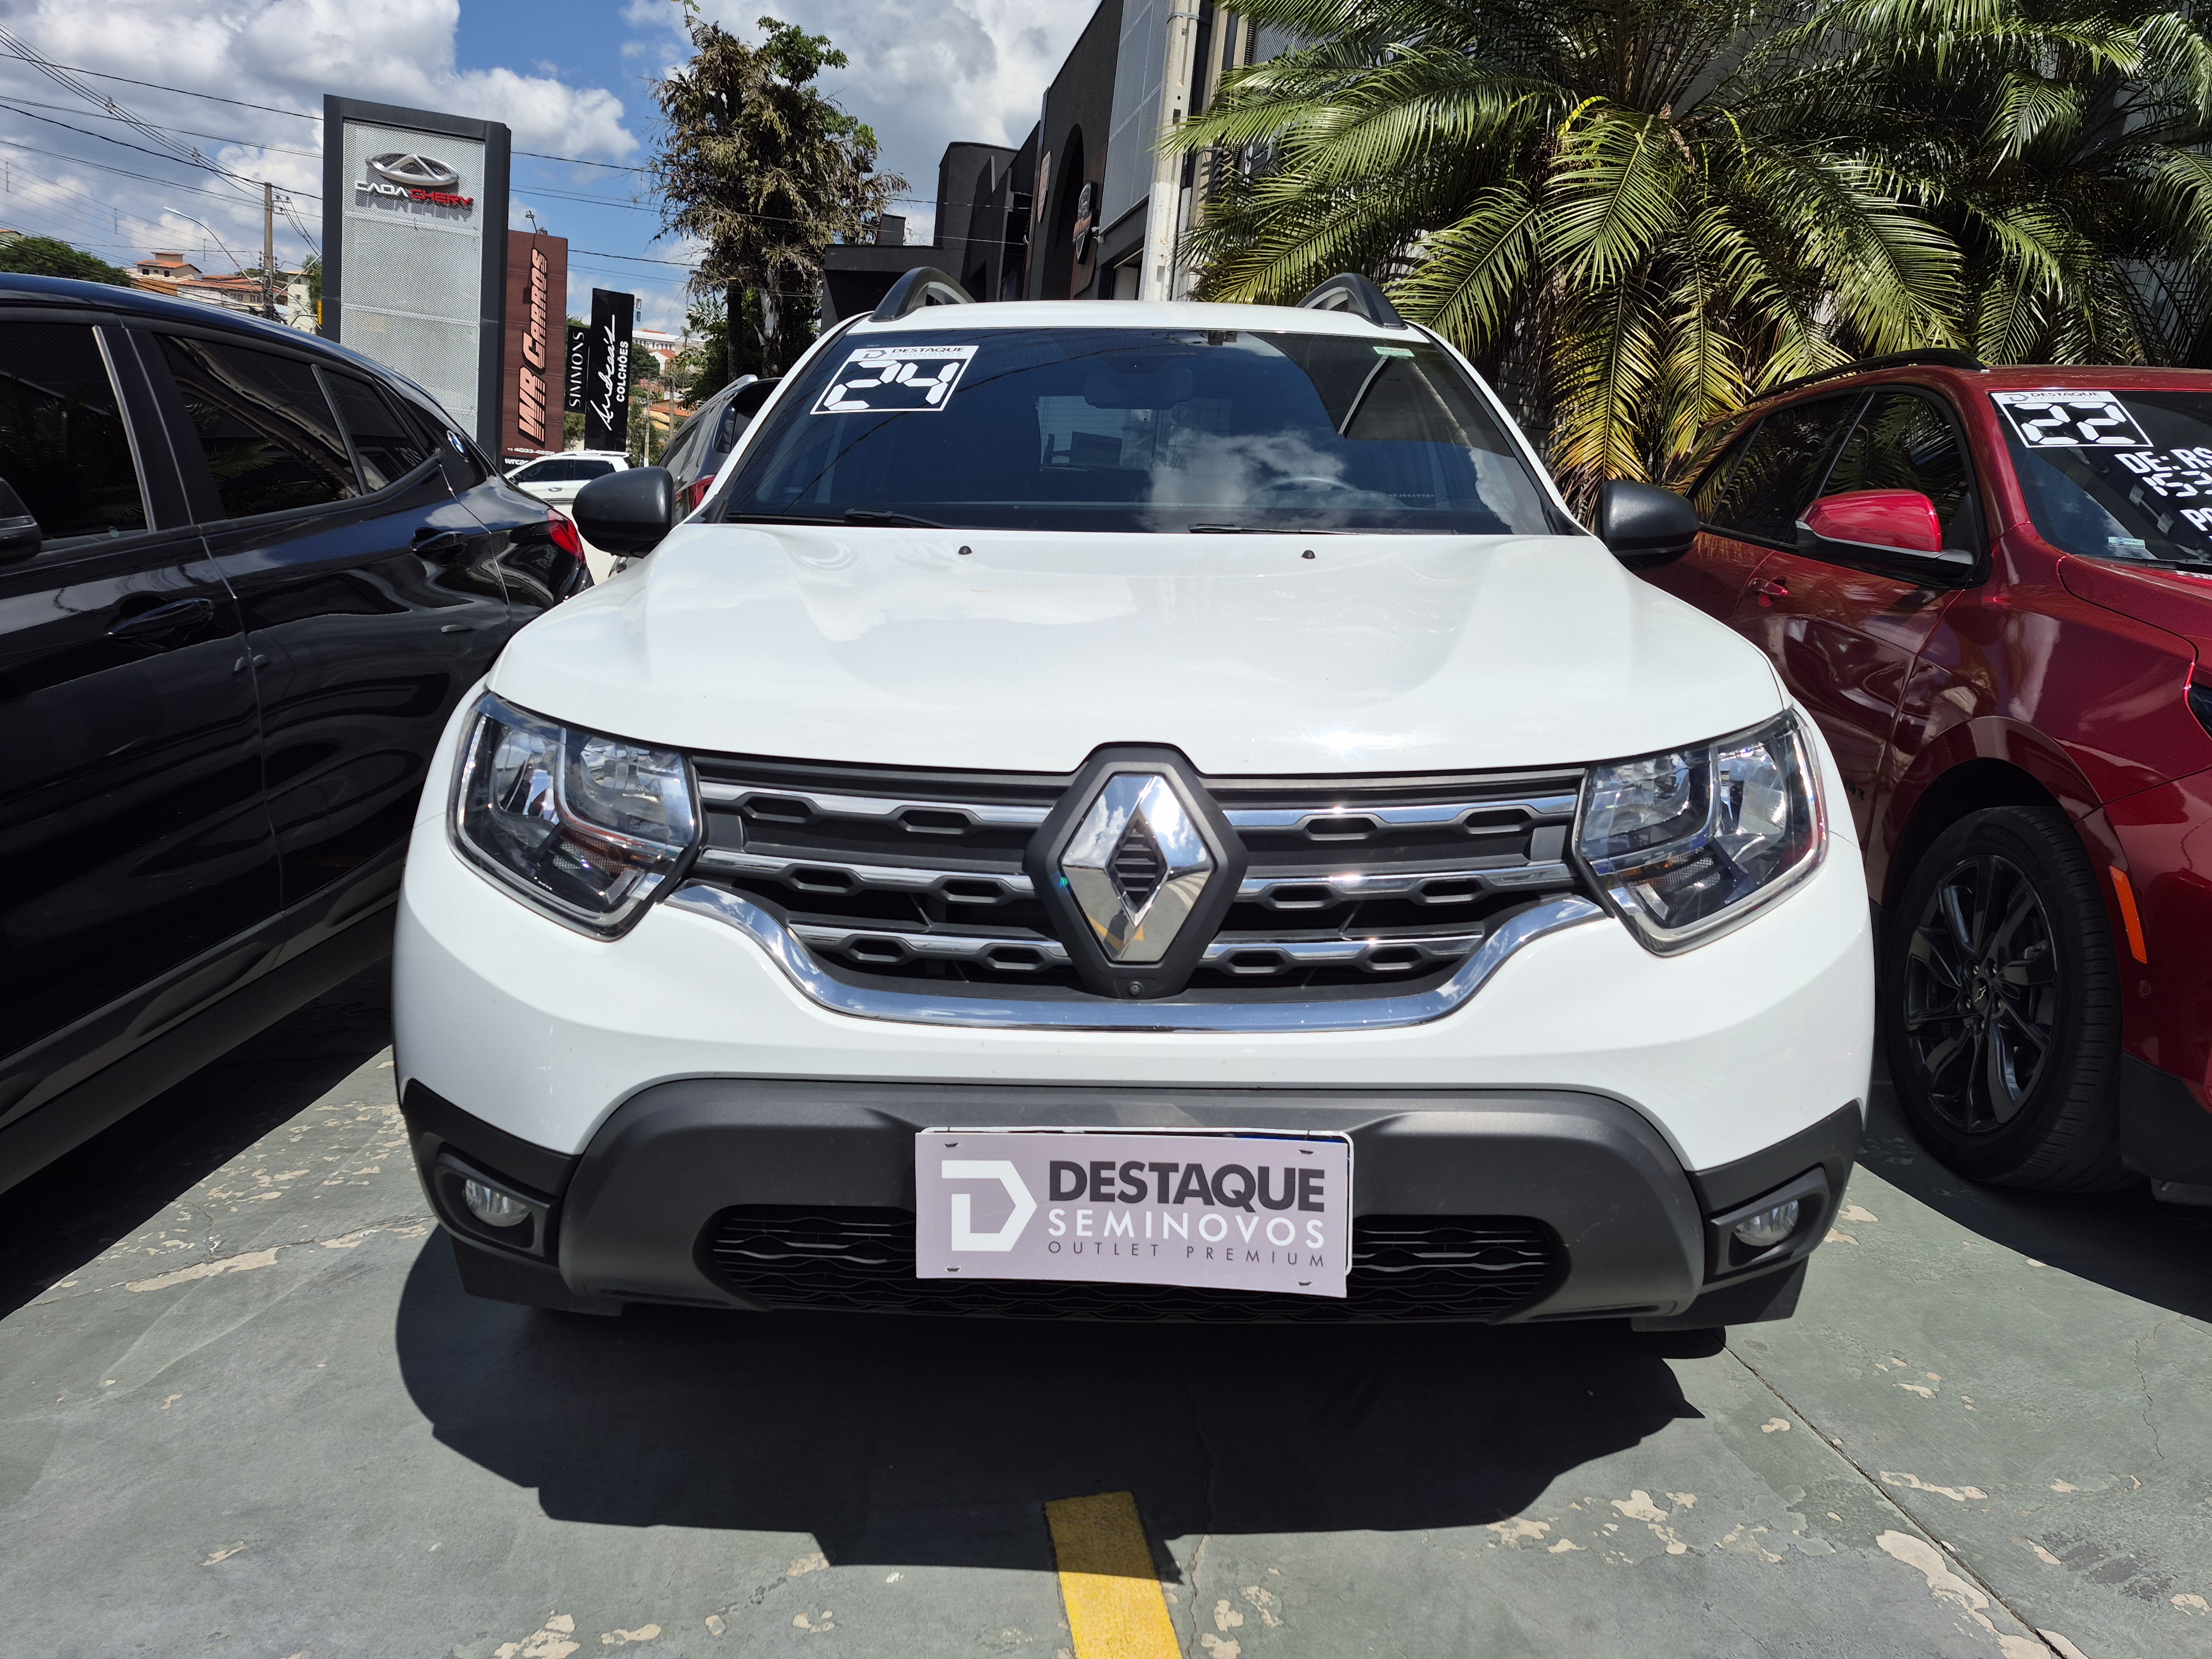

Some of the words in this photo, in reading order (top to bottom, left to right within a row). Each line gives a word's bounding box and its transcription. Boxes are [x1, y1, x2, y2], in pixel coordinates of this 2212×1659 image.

[410, 188, 474, 206] CHERY
[569, 331, 584, 408] SIMMONS
[616, 341, 629, 403] COLCHÕES
[823, 359, 960, 411] 24
[518, 366, 546, 442] WR
[2013, 401, 2136, 445] 22
[2114, 451, 2182, 474] DE:
[1048, 1160, 1325, 1213] DESTAQUE
[1048, 1209, 1324, 1249] SEMINOVOS
[1048, 1240, 1159, 1256] OUTLET
[1186, 1245, 1324, 1267] PREMIUM
